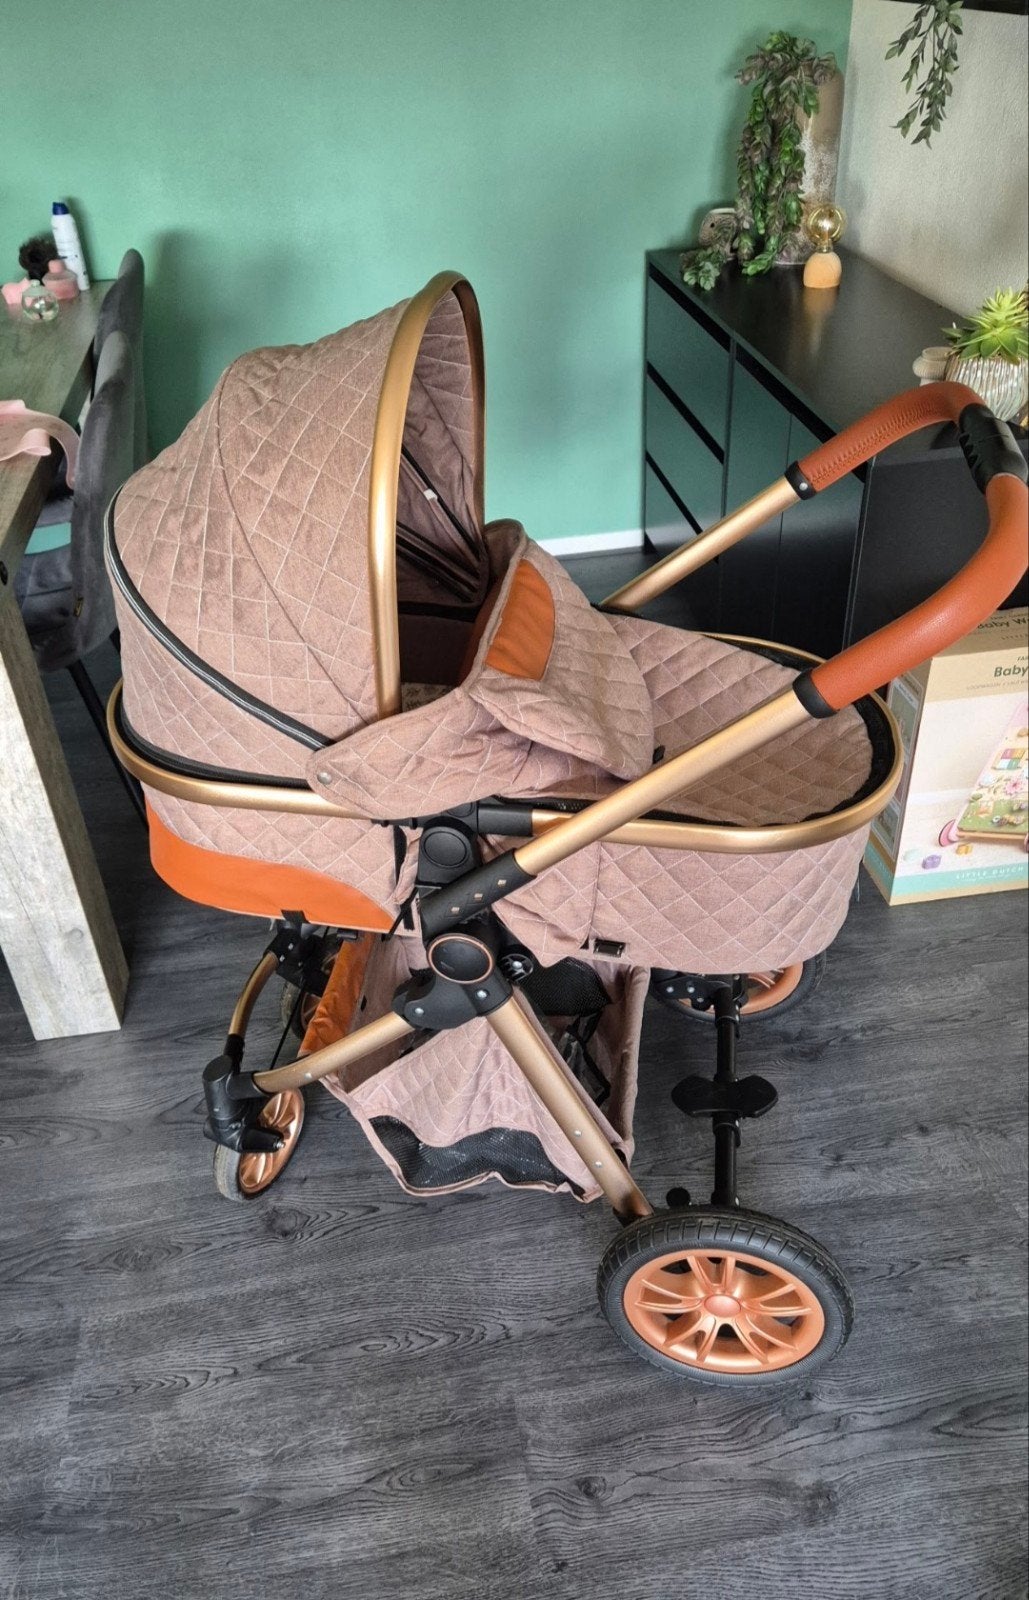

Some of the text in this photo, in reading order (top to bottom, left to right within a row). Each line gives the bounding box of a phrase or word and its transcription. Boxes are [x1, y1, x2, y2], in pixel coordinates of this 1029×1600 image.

[994, 665, 1028, 677] Baby
[956, 871, 987, 879] LITTLE
[992, 866, 1023, 875] DUTCH
